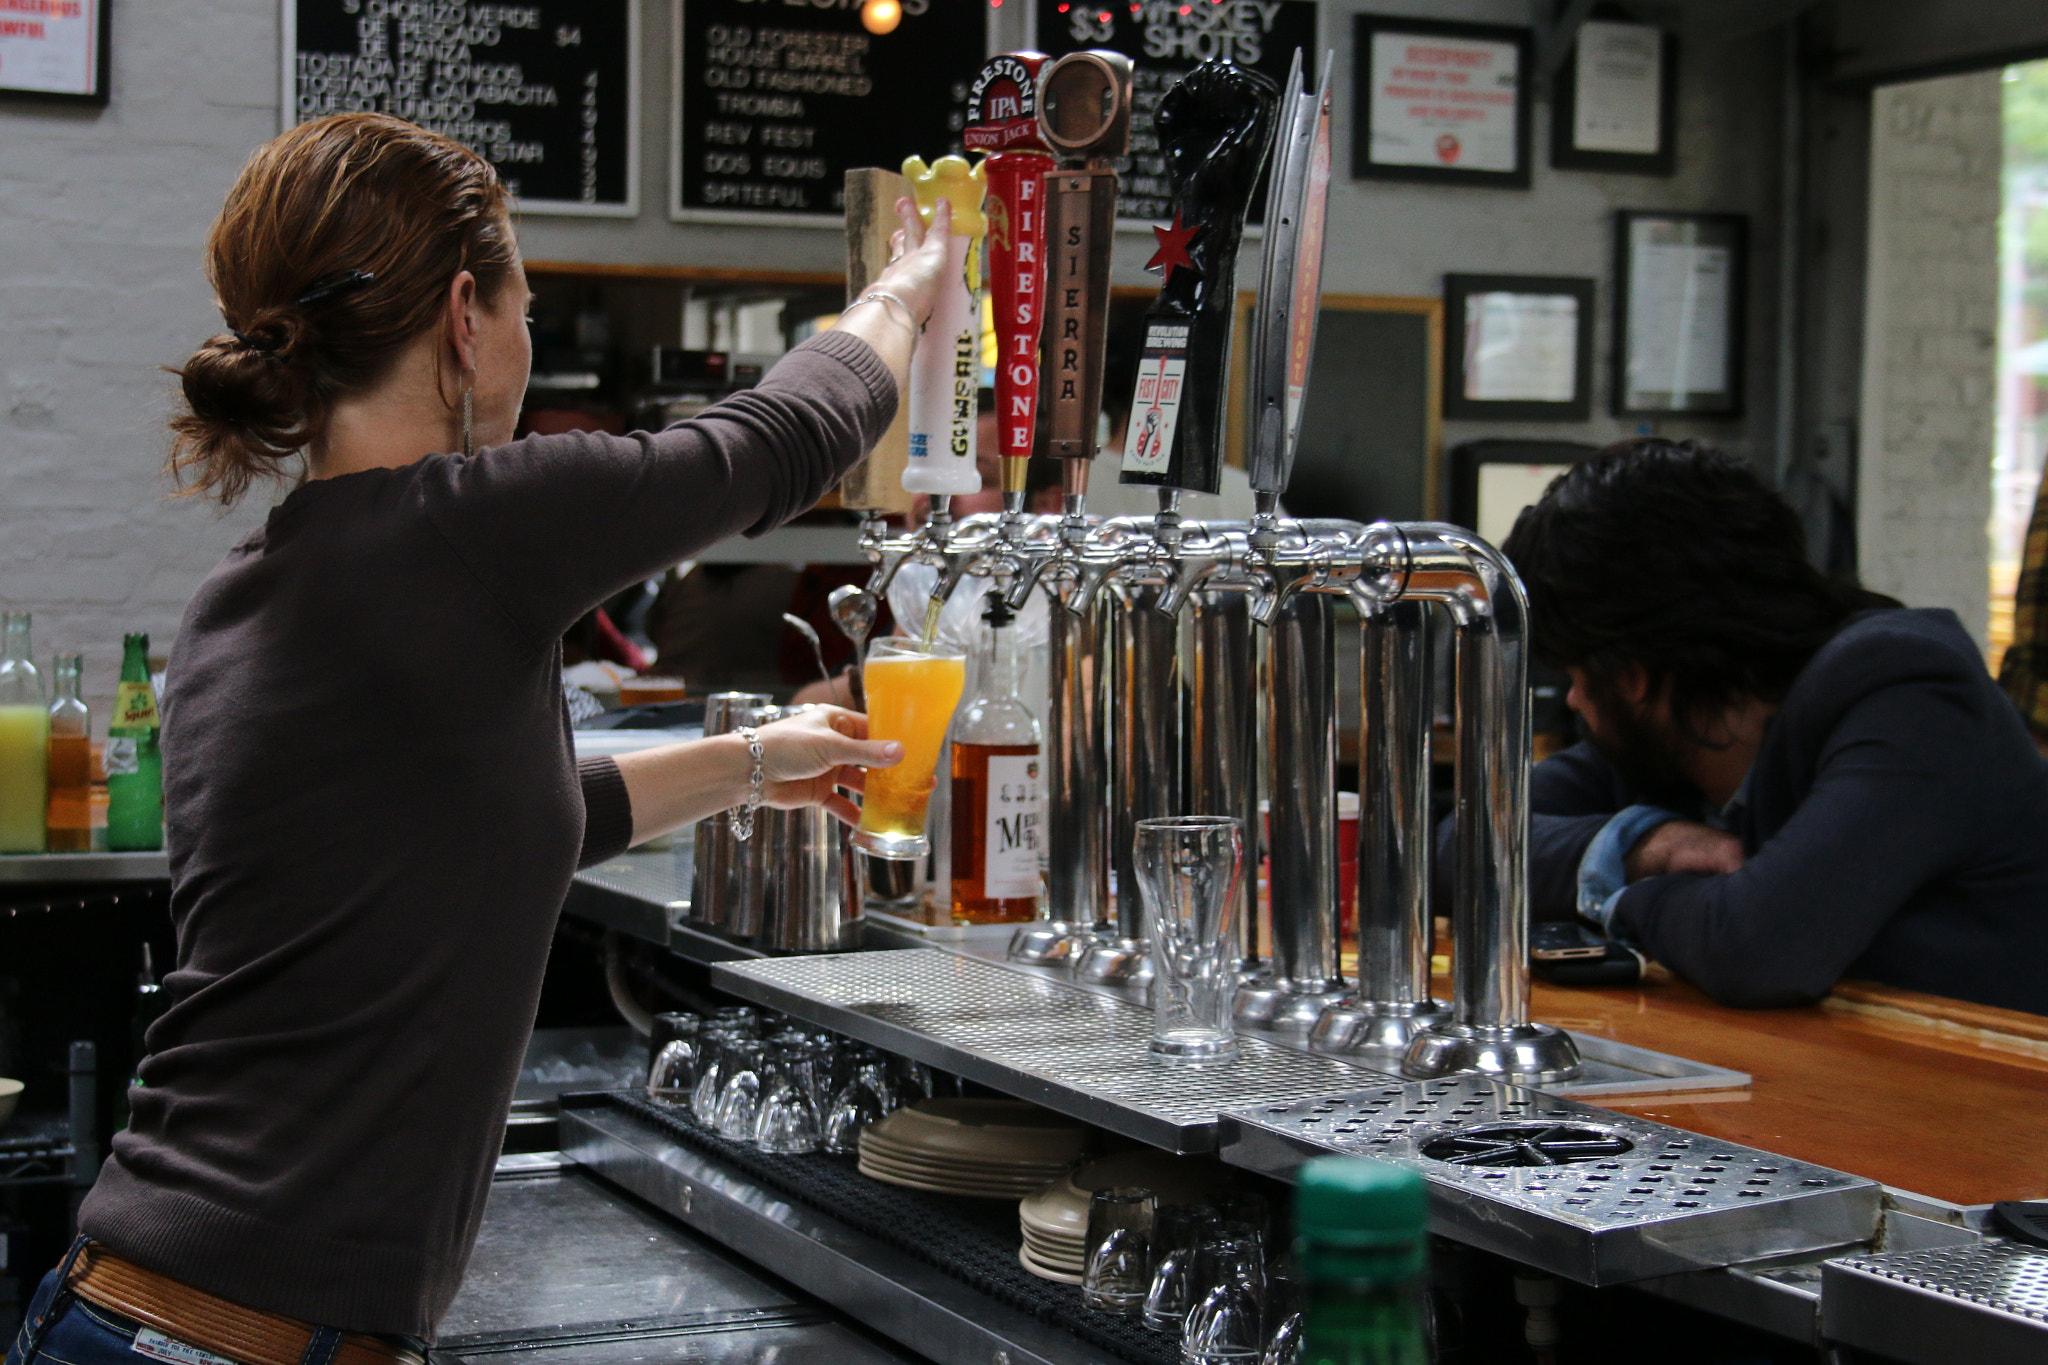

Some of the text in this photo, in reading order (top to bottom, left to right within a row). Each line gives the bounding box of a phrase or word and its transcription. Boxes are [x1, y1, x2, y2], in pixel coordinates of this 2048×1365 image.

[469, 4, 541, 29] VERDE
[358, 17, 501, 46] DE PESCADO
[705, 24, 751, 47] OLD
[359, 38, 389, 59] DE
[1143, 25, 1263, 64] SHOTS
[298, 53, 395, 77] TOSTADA
[398, 60, 428, 80] DE
[704, 67, 751, 88] OLD
[298, 75, 392, 97] TOSTADA
[395, 79, 425, 99] DE
[967, 58, 1035, 122] FIRESTONE
[989, 96, 1020, 121] IPA
[965, 123, 1031, 147] UNION JACK
[702, 181, 809, 208] SPITEFUL
[1294, 206, 1318, 382] SNAPSHOT
[1011, 180, 1036, 448] FIRESTONE
[1060, 226, 1081, 400] SIERRA
[1145, 337, 1188, 348] BREWING
[1137, 378, 1180, 400] FIST CITY
